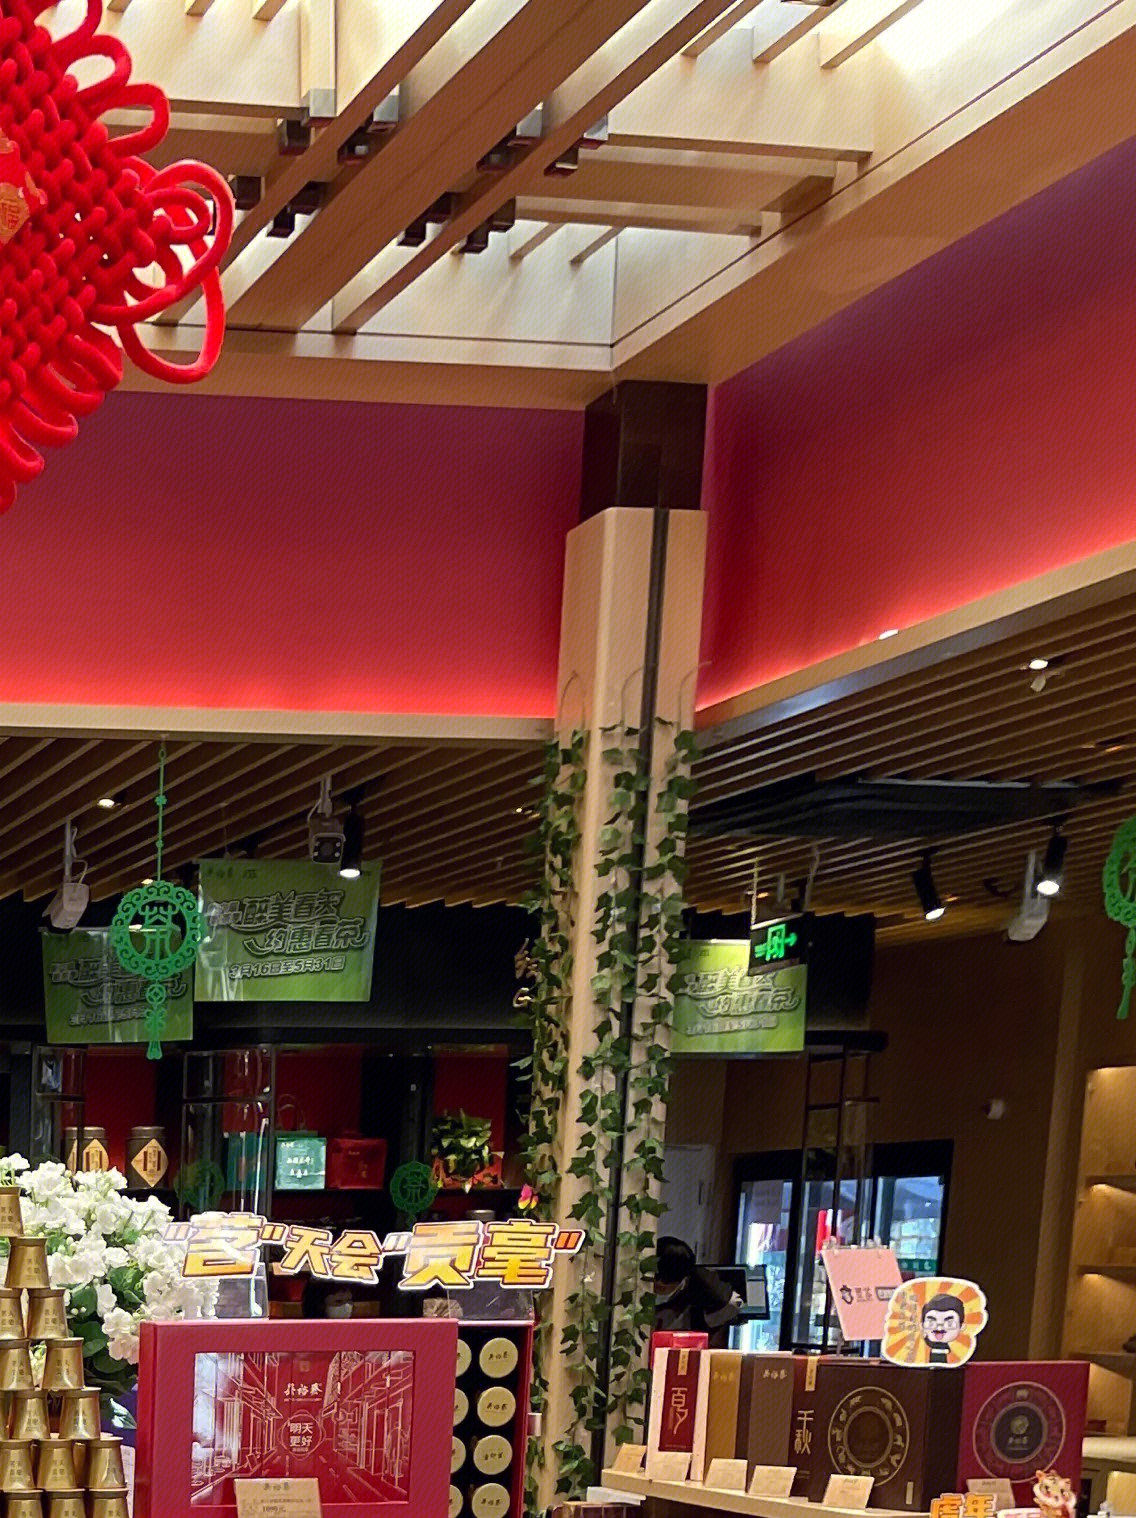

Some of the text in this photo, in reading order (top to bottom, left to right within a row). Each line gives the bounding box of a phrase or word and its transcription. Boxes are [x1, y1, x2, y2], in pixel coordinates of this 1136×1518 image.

[239, 888, 346, 926] 醉美春天
[243, 919, 371, 956] 约惠春茶
[229, 955, 347, 980] 3月16日至5月31日
[289, 1421, 314, 1435] 明天
[289, 1435, 314, 1449] 更好
[794, 1409, 815, 1456] 千秋
